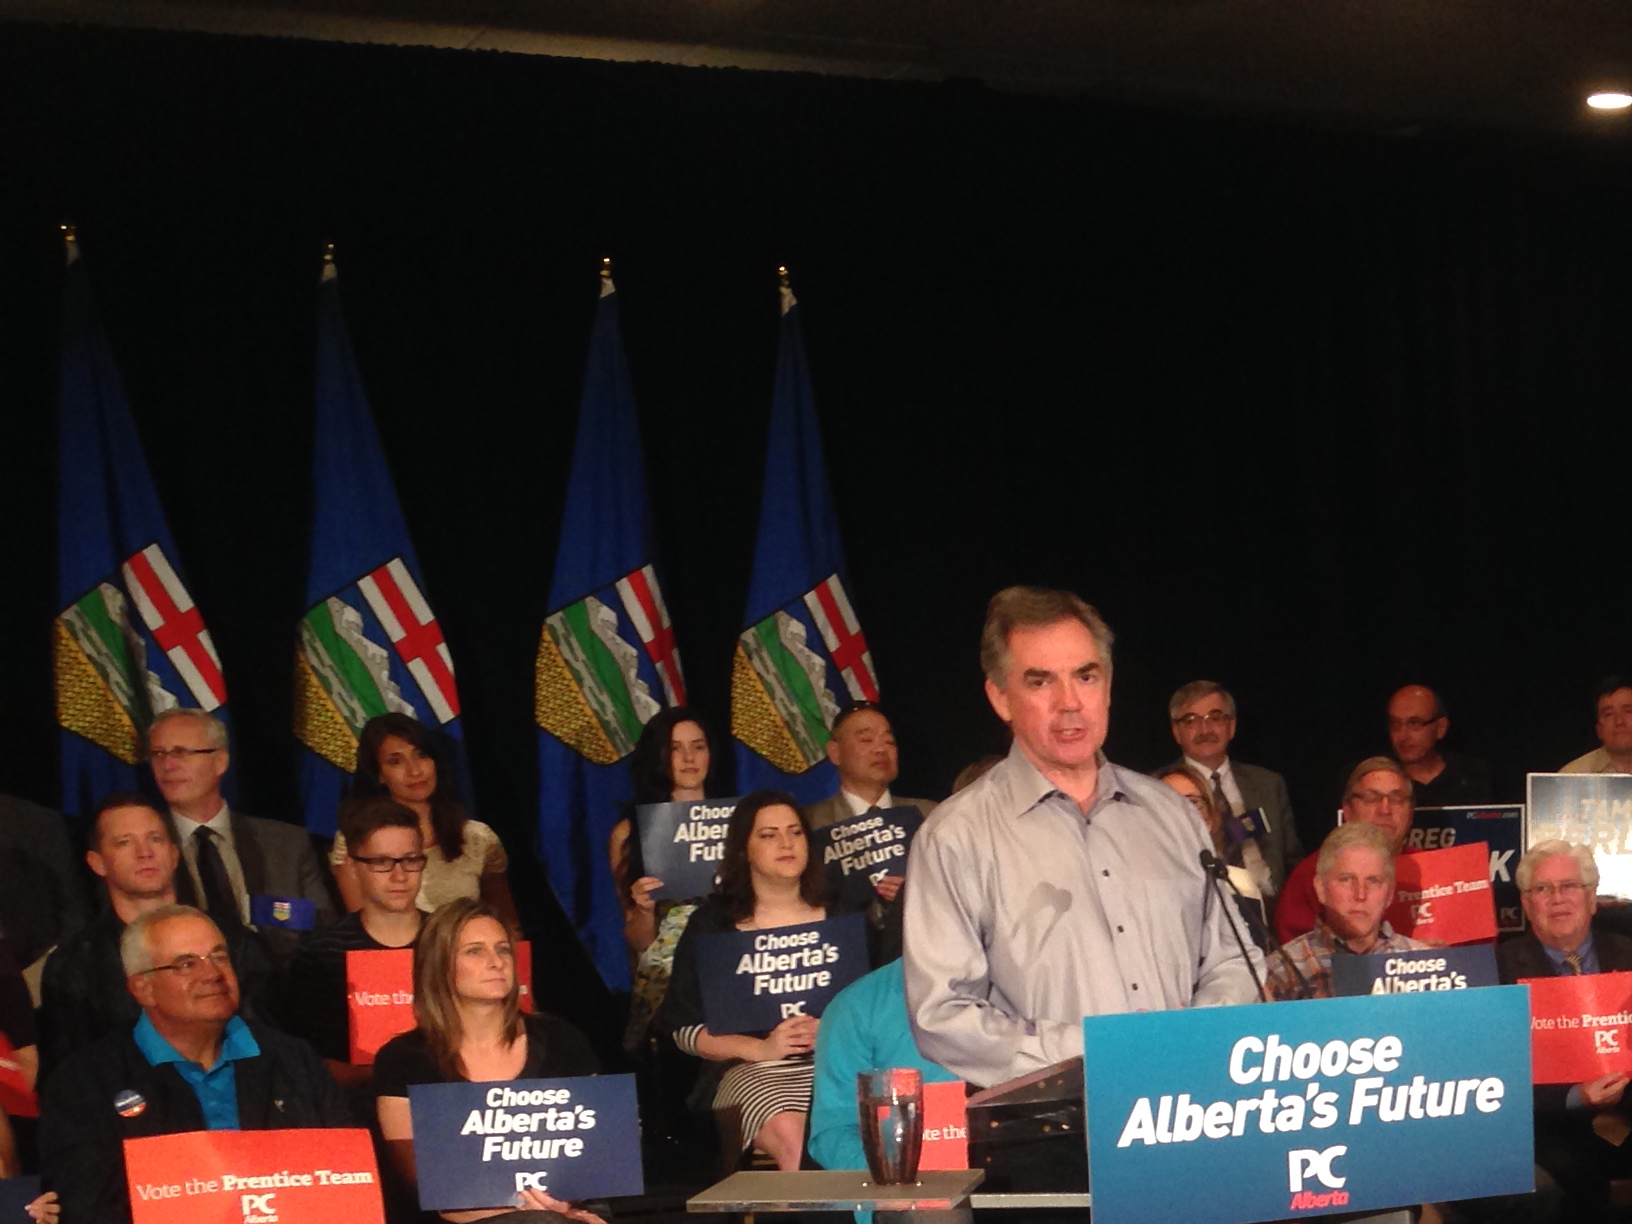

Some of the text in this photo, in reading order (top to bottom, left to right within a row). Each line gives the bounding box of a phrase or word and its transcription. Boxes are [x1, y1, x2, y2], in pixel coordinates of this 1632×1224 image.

[829, 815, 884, 841] Choose
[1402, 827, 1457, 848] REG
[822, 823, 906, 864] Alberta's
[840, 843, 906, 877] Future
[1454, 879, 1490, 894] Team
[753, 930, 820, 952] Choose
[735, 943, 840, 976] Alberta's
[1384, 958, 1448, 977] Choose
[753, 968, 832, 996] Future
[354, 989, 414, 1006] Vote th
[780, 1000, 807, 1020] PC
[1557, 1014, 1580, 1030] the
[1593, 1030, 1620, 1048] PC
[1227, 1034, 1404, 1086] Choose
[485, 1085, 571, 1109] Choose
[459, 1105, 597, 1137] Alberta's
[1116, 1075, 1506, 1149] Alberta's Future
[480, 1134, 585, 1163] Future
[1287, 1145, 1349, 1194] PC
[136, 1165, 374, 1203] Vote the Prentice Team
[514, 1170, 549, 1194] PC
[240, 1193, 276, 1217] PC
[1289, 1190, 1349, 1211] Alberta
